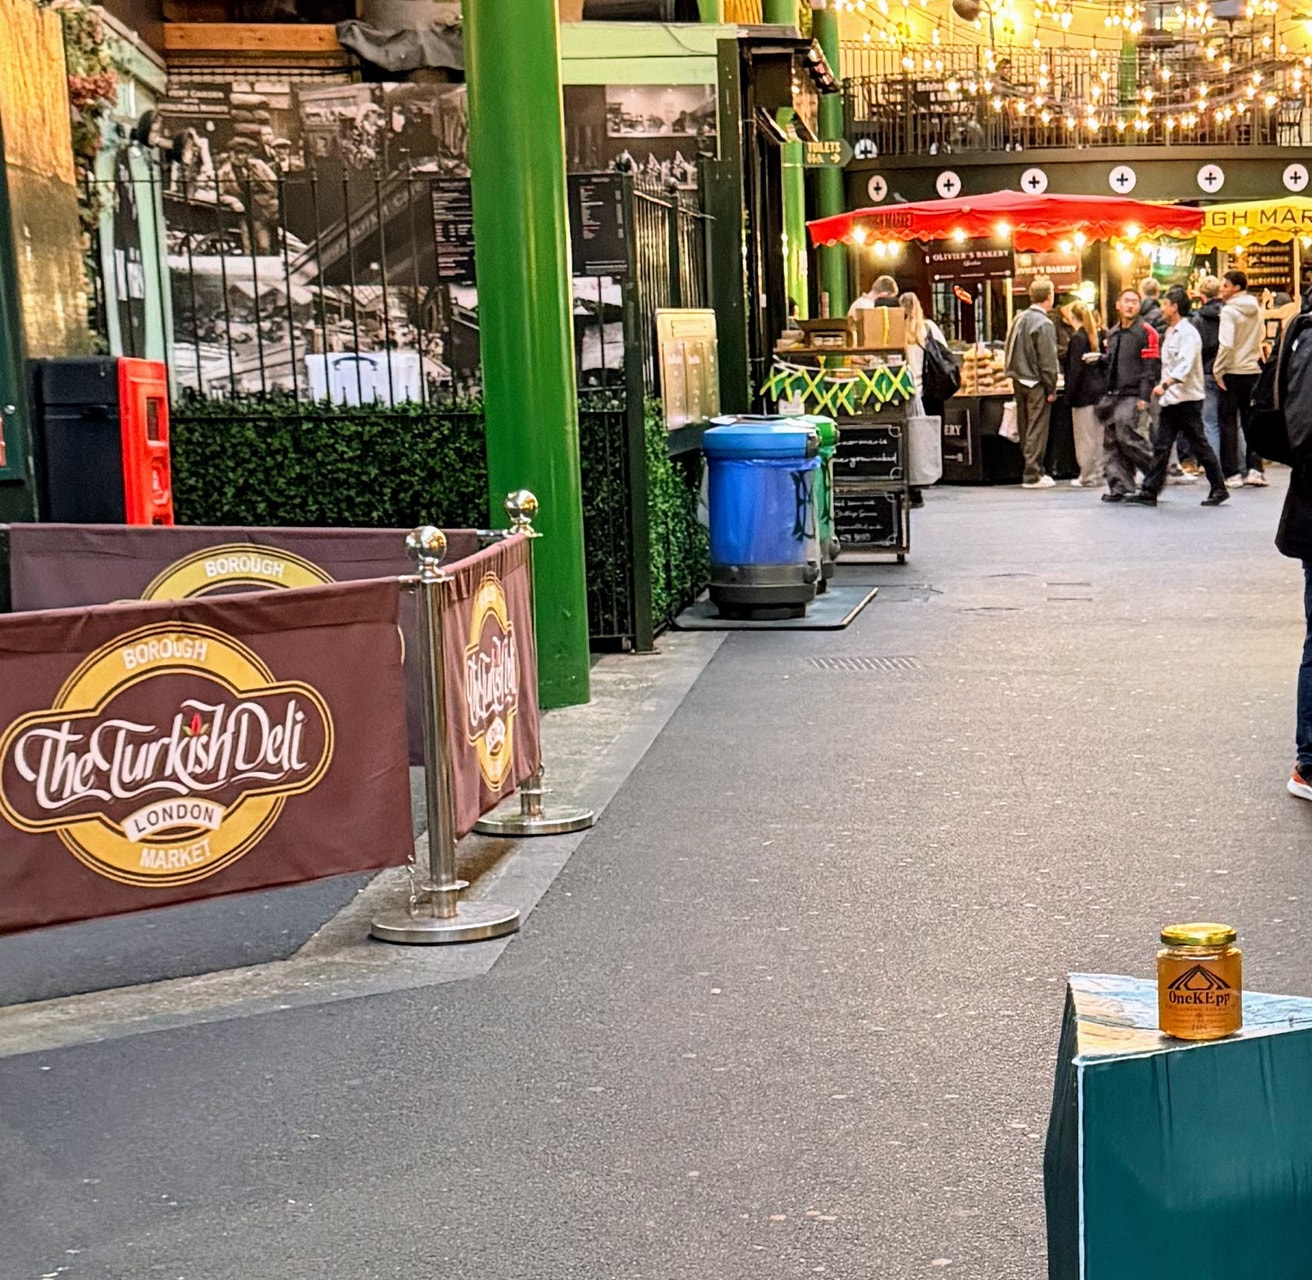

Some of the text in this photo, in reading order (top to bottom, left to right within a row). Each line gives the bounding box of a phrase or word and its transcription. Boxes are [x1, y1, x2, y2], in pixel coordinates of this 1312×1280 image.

[933, 250, 1009, 261] OLIVIER'S BAKERY
[944, 424, 962, 436] ERY
[204, 557, 284, 578] BOROUGH
[122, 638, 208, 670] BOROUGH
[14, 699, 307, 809] The Turkish Deli
[134, 804, 215, 833] LONDON
[139, 837, 211, 870] MARKET
